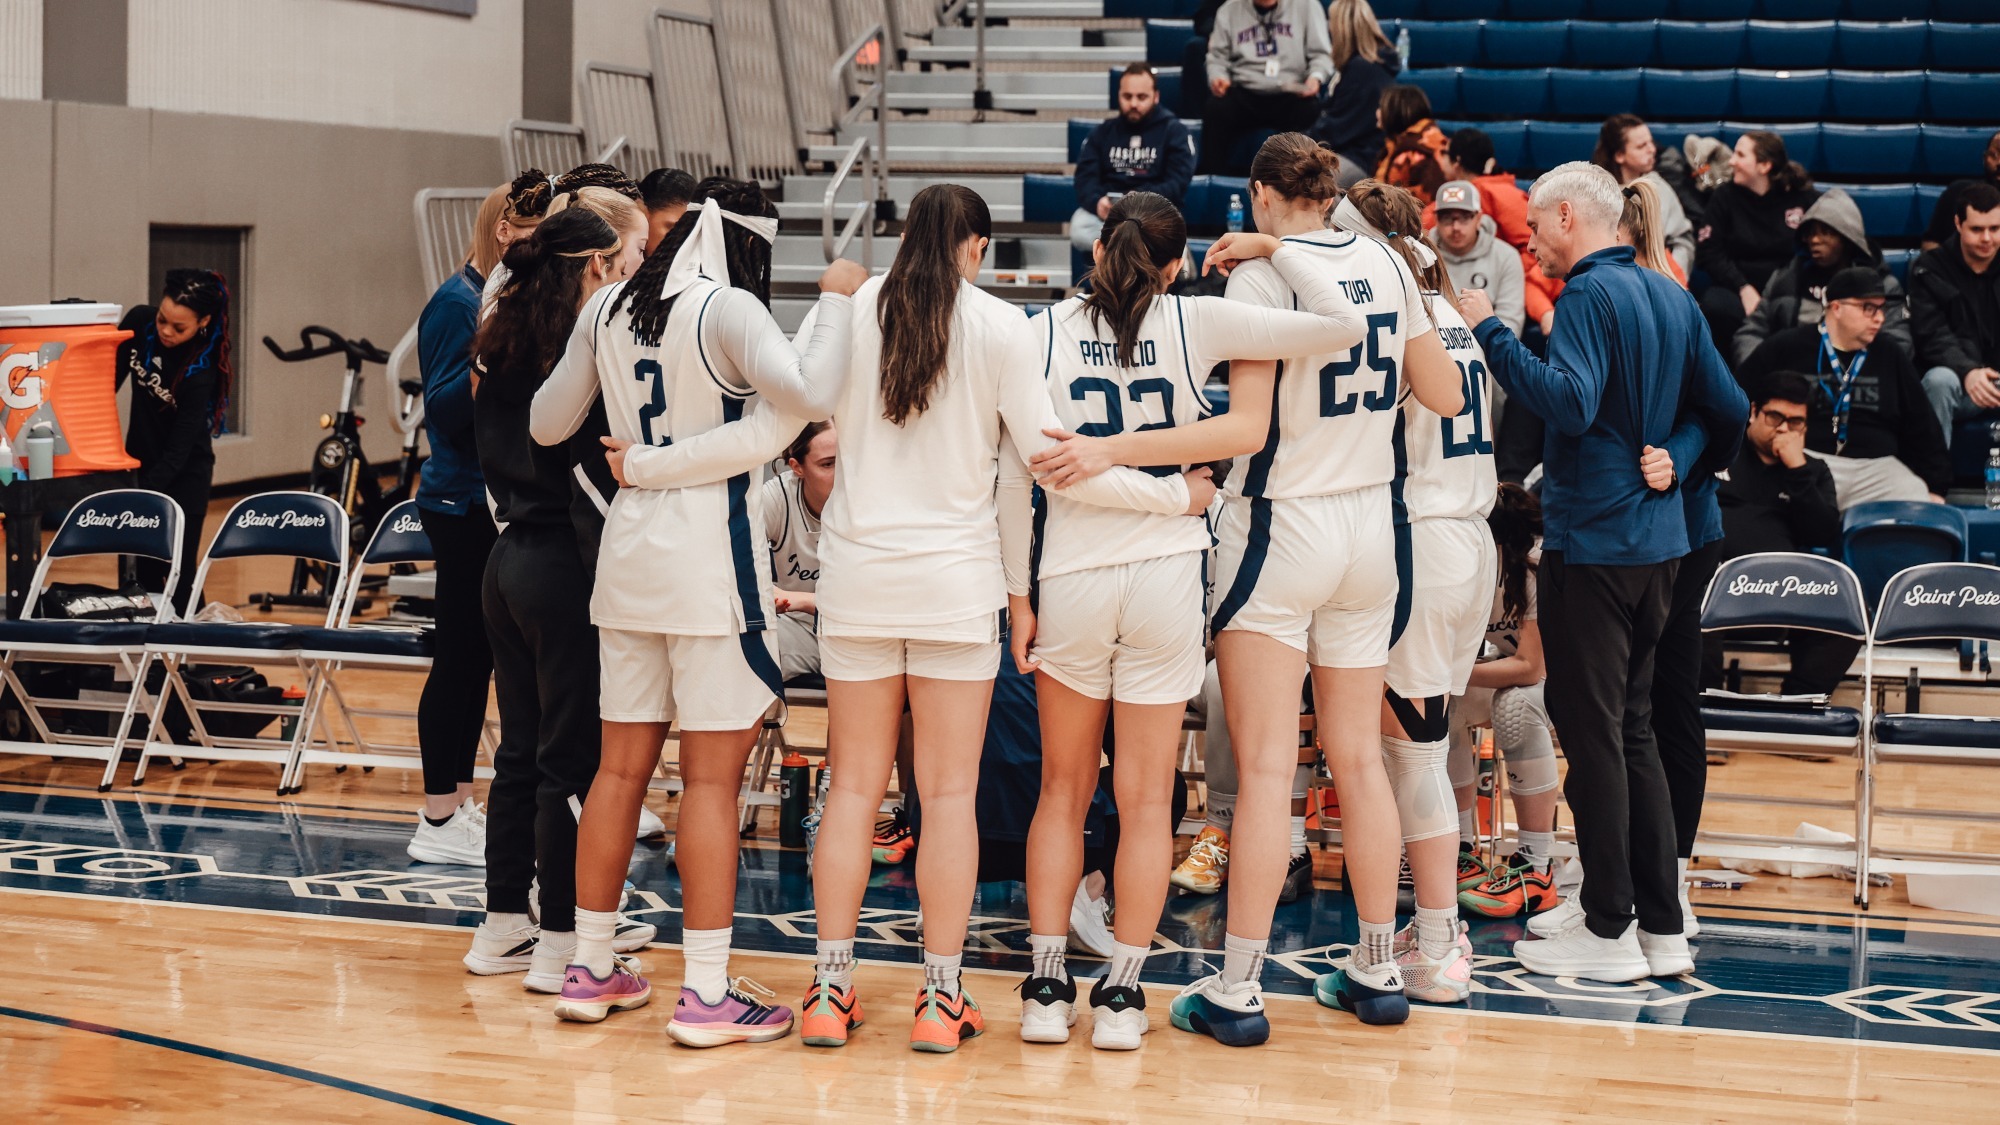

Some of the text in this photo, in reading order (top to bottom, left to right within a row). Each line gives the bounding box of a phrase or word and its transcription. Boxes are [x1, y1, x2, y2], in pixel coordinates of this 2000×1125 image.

[1338, 279, 1374, 305] TURI
[1439, 326, 1475, 350] SUNDAY
[1079, 340, 1156, 368] PATRCIO
[1319, 311, 1398, 418] 25
[0, 351, 42, 410] G
[634, 359, 673, 447] 2
[76, 509, 160, 530] Saint Peter's
[236, 509, 326, 529] Saint Peter's
[392, 514, 423, 533] Sai
[1727, 574, 1838, 598] Saint Peter's
[1903, 584, 2000, 608] Saint Pete
